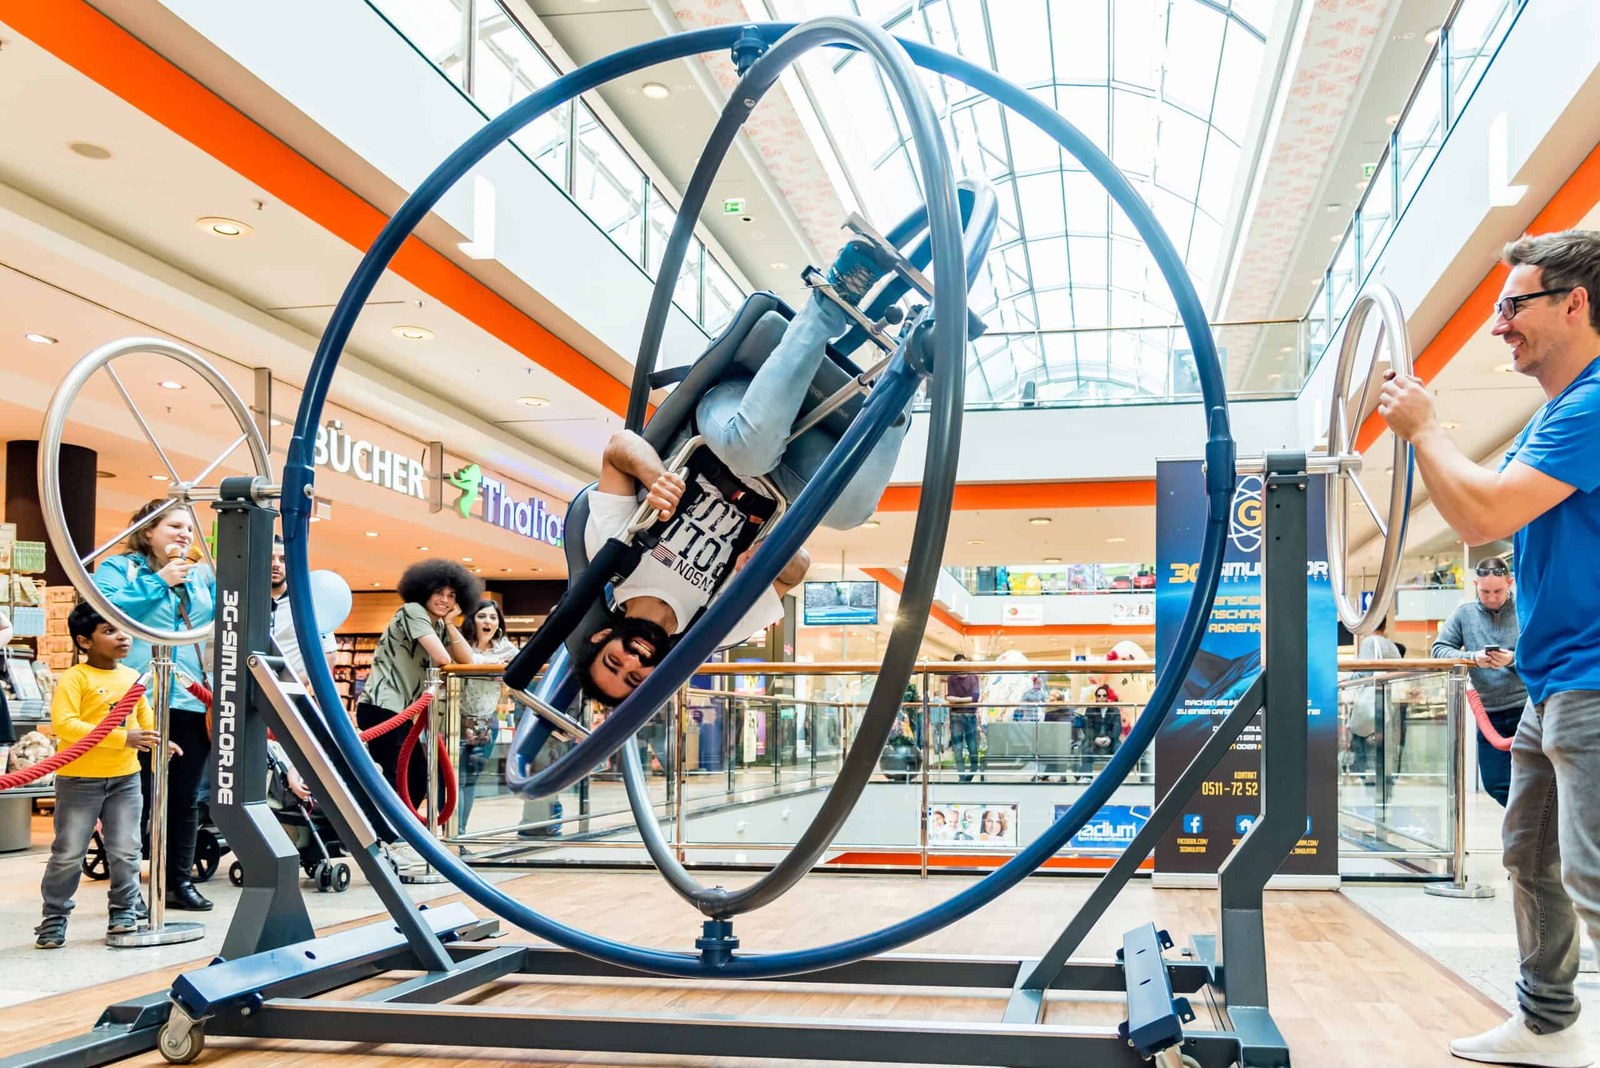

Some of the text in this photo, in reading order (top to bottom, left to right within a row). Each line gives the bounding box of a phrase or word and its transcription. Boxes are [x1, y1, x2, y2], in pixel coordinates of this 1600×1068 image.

[314, 419, 425, 499] BÜCHER
[481, 475, 563, 547] Thalia
[673, 559, 714, 596] NSON
[217, 589, 239, 806] 3G-SIMULATOR.DE
[1245, 781, 1259, 796] 52
[1077, 820, 1137, 838] adium
